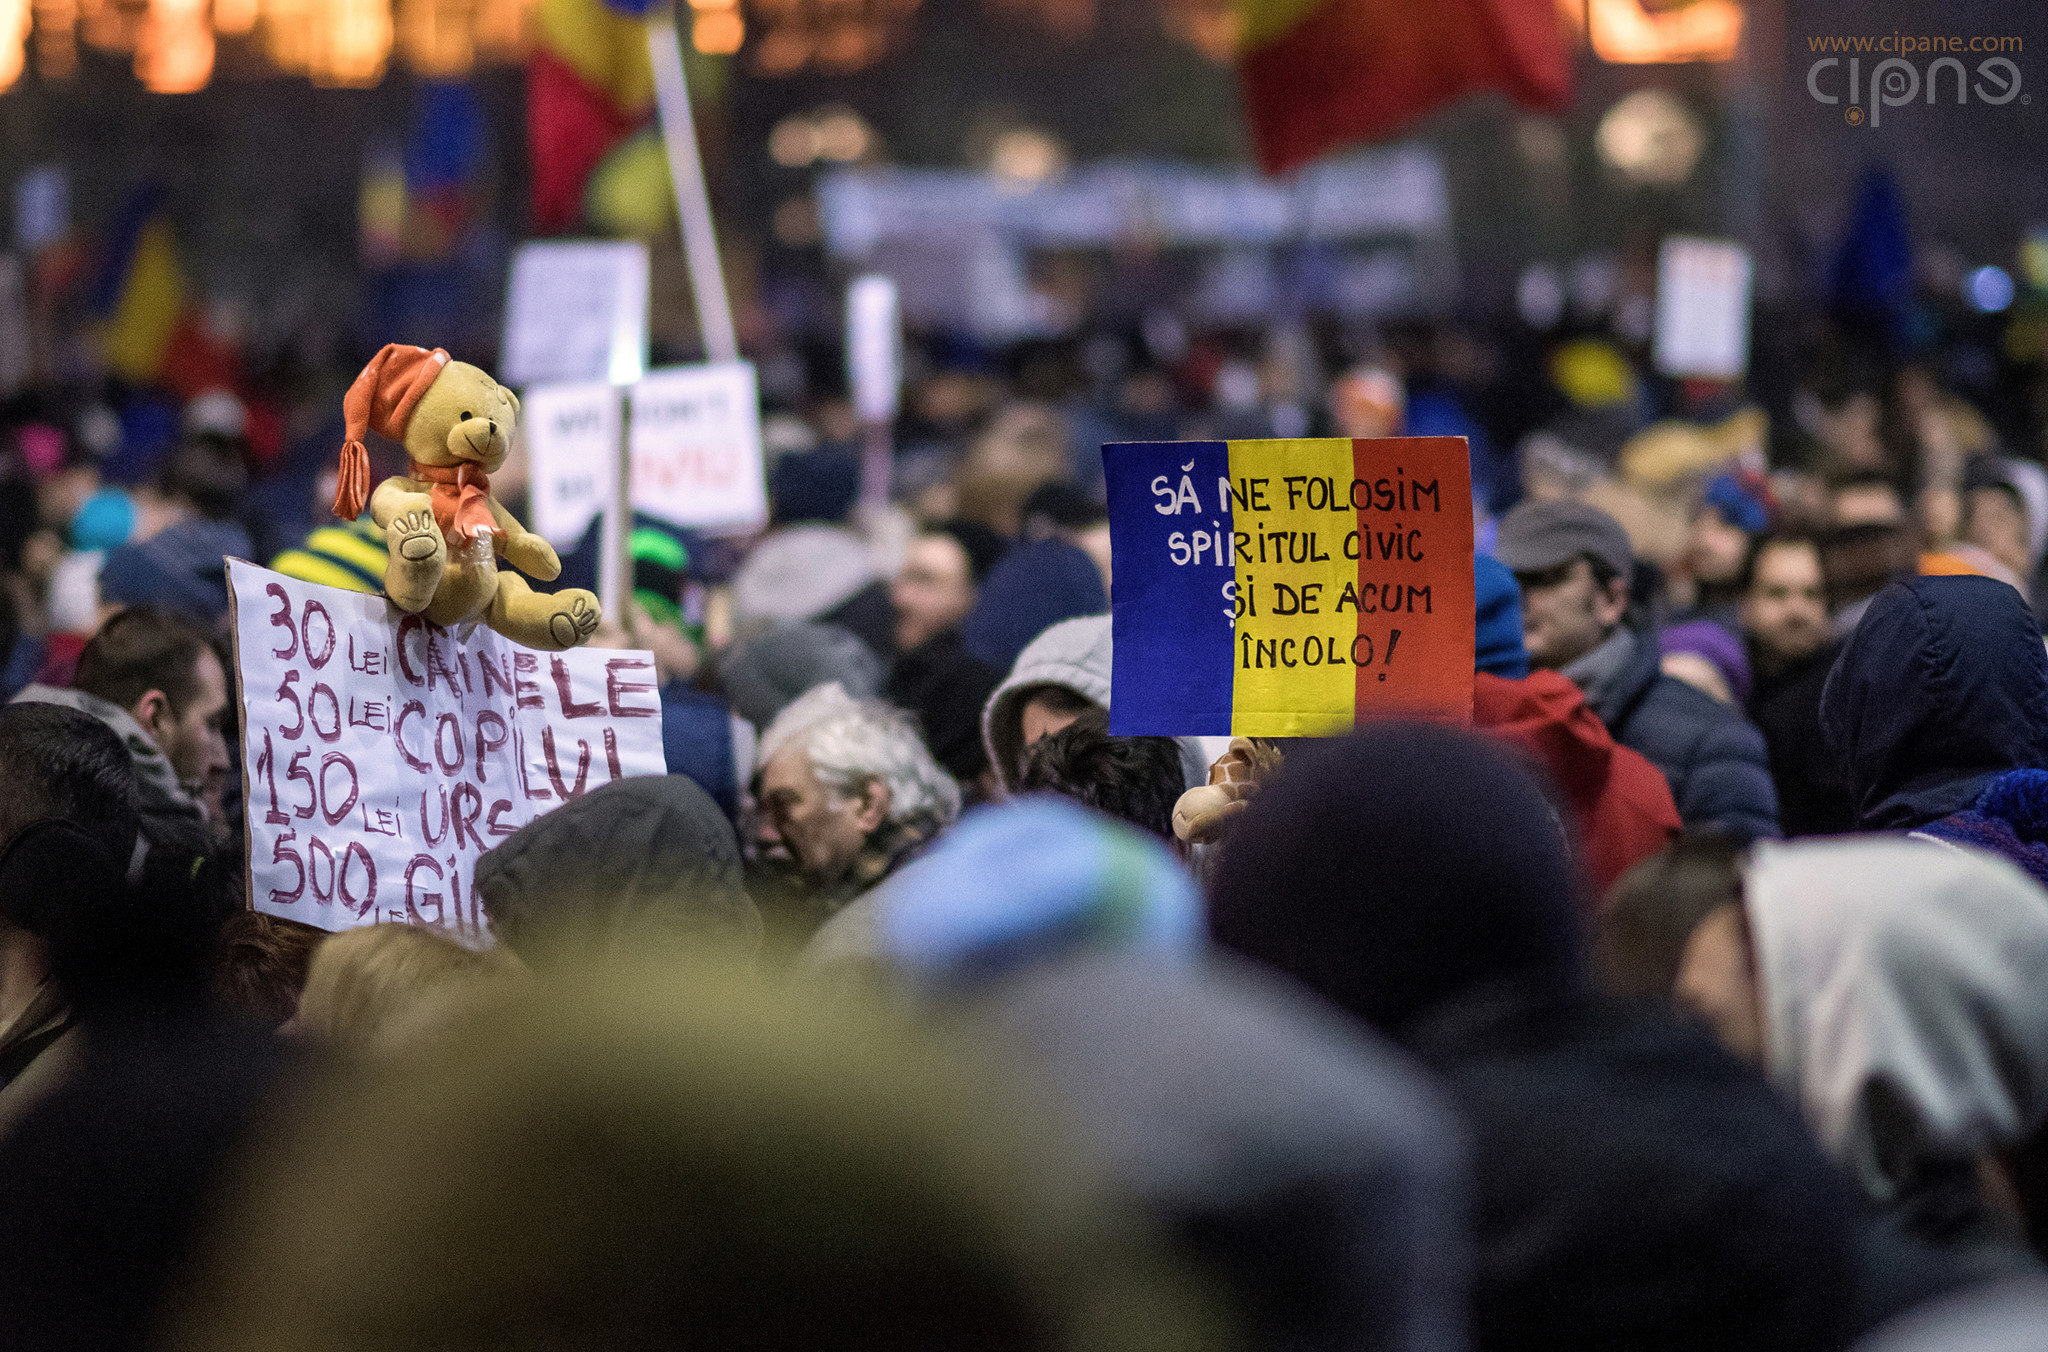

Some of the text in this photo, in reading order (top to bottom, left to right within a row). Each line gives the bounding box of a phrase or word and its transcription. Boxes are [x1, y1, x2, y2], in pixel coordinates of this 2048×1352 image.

[1151, 458, 1202, 515] SĂ
[1218, 476, 1271, 513] NE
[265, 582, 336, 671] 30
[1272, 582, 1324, 616] DE
[1335, 581, 1432, 614] ACUM
[275, 669, 342, 743] 50
[257, 727, 360, 826] 150
[269, 828, 378, 920] 500
